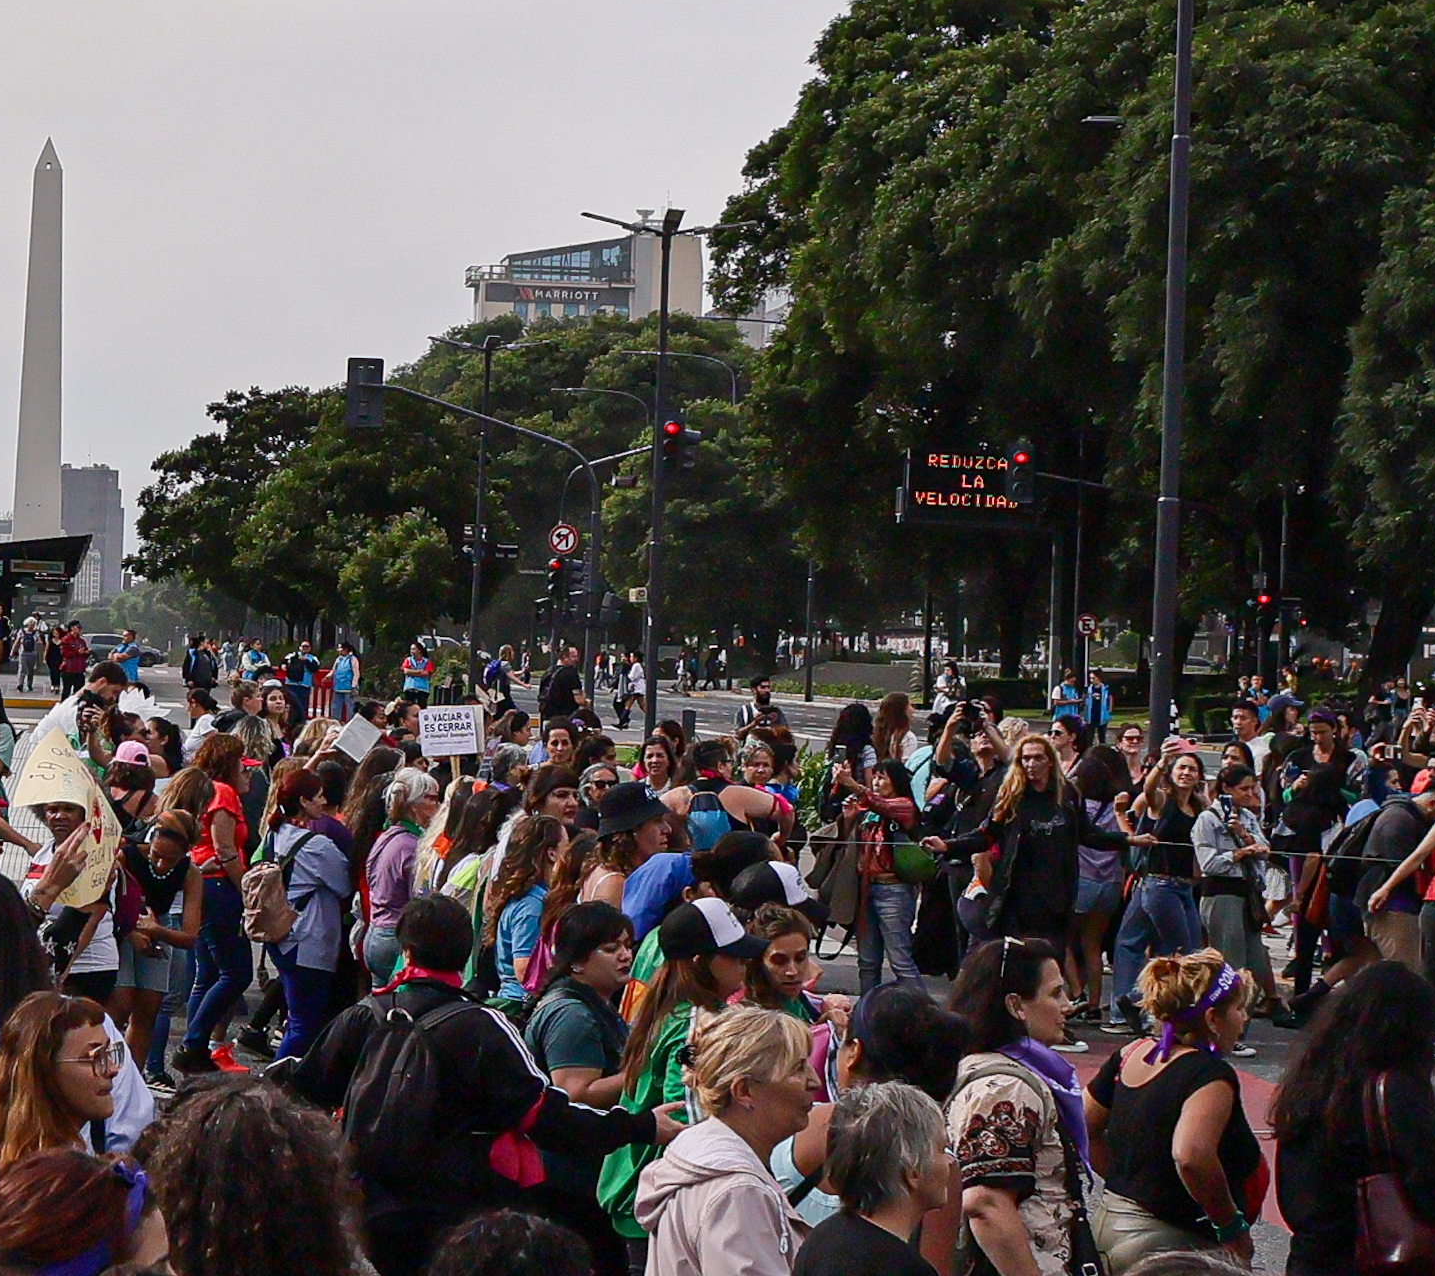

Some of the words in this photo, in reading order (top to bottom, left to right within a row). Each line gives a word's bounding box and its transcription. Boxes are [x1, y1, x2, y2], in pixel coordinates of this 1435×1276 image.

[535, 289, 599, 301] MARRIOTT
[927, 453, 1008, 471] REDUZCA
[961, 473, 985, 489] LA
[431, 712, 463, 722] VACIAR
[424, 723, 436, 733] ES
[437, 721, 472, 732] CERRAR
